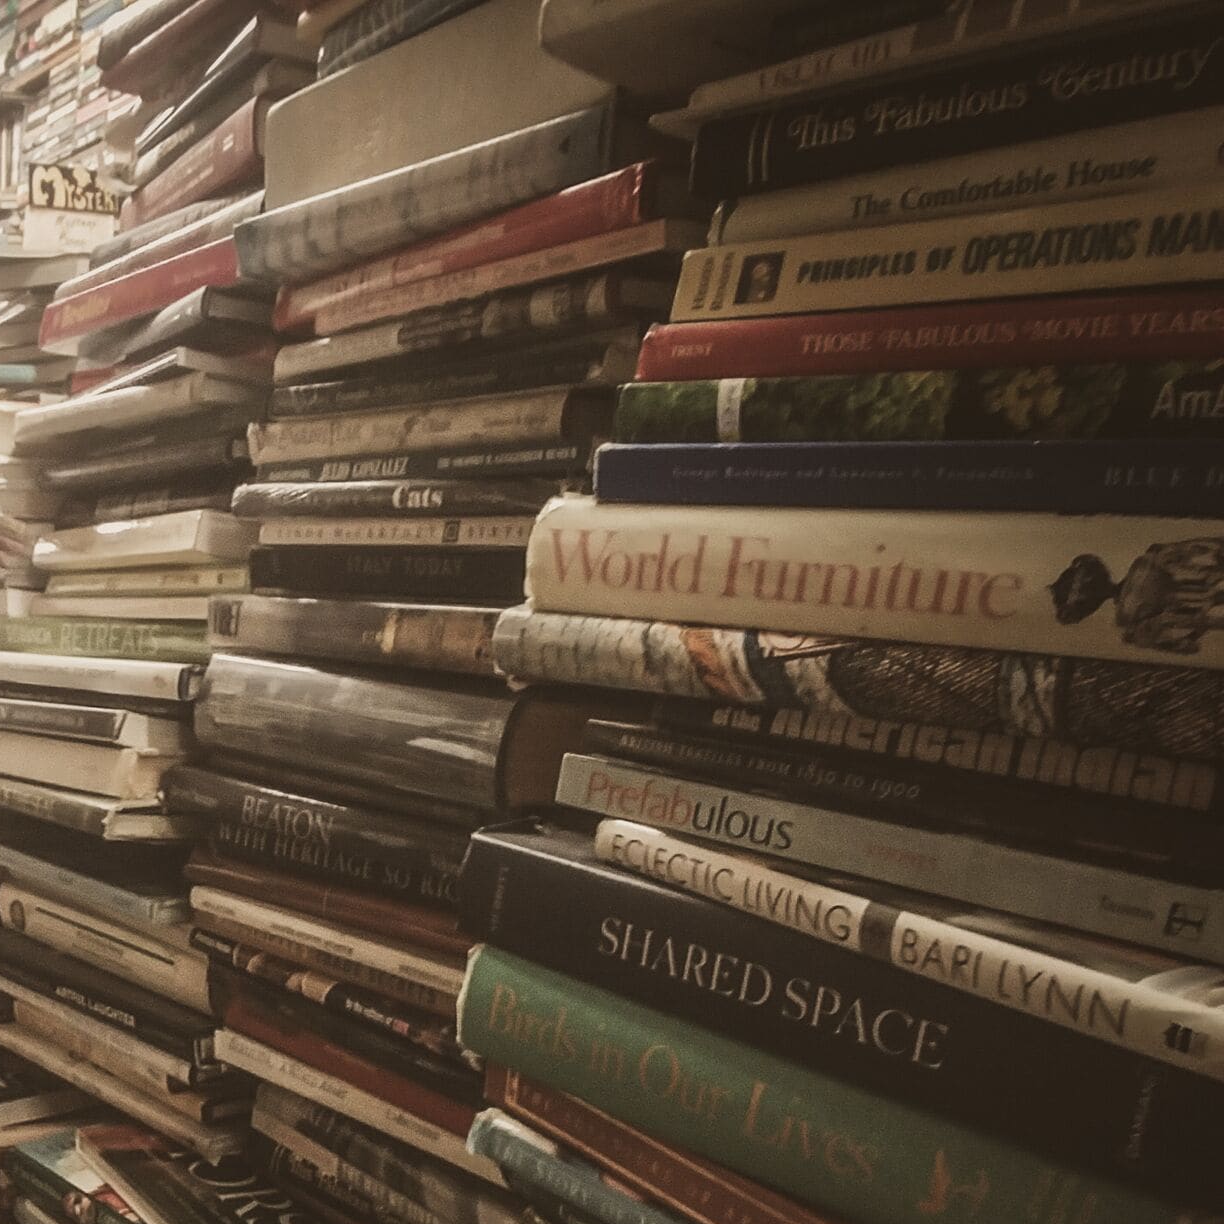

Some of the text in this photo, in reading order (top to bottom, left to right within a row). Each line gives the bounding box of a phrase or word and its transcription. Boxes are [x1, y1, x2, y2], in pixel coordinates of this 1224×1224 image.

[789, 36, 1224, 151] This Fabulous Century
[850, 155, 1158, 219] The Comfortable House
[796, 250, 917, 285] PRINCIPLES
[925, 248, 957, 273] OF
[962, 219, 1141, 277] OPERATIONS
[801, 330, 873, 356] THOSE
[884, 321, 1018, 352] FABULOUS
[1028, 312, 1116, 343] MOVIE
[392, 481, 444, 508] Cats
[548, 525, 1028, 625] World Furniture
[770, 706, 1016, 778] American
[1015, 737, 1218, 812] Indian
[870, 774, 923, 801] 1900
[242, 793, 336, 848] BEATON
[585, 768, 796, 852] Prefabulous
[273, 837, 373, 881] HERITAGE
[420, 873, 462, 903] RIC
[608, 832, 856, 946] ECLECTIC LIVING
[599, 915, 951, 1070] SHARED SPACE
[996, 959, 1134, 1040] LYNN
[488, 979, 576, 1058] Birds
[589, 1035, 627, 1081] in
[638, 1043, 732, 1121] Our
[742, 1078, 876, 1182] Lives
